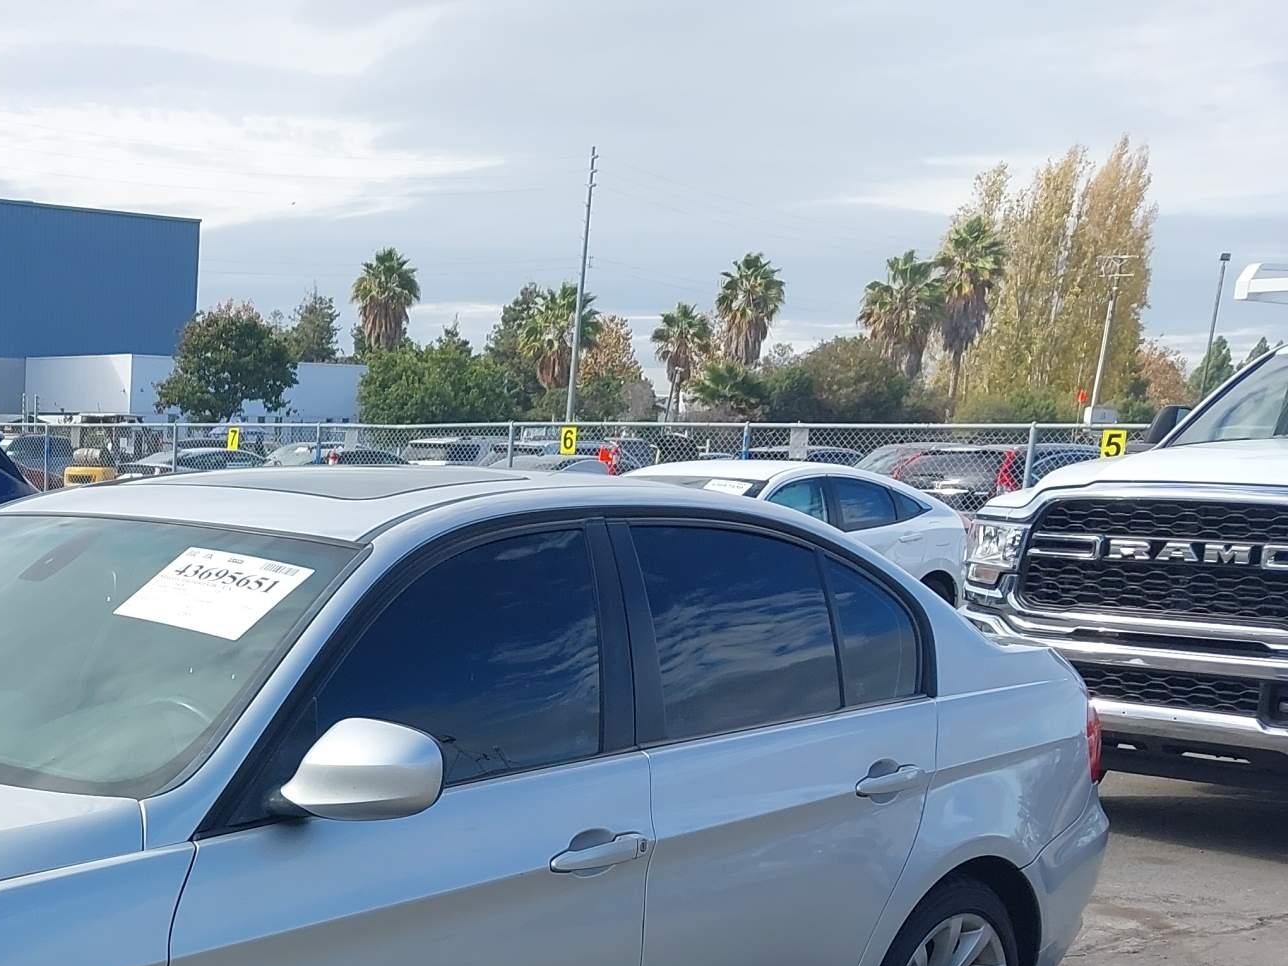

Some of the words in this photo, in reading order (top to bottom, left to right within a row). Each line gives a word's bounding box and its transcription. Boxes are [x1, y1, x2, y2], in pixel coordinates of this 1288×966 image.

[230, 429, 238, 447] 7
[563, 429, 574, 450] 6
[1104, 433, 1122, 458] 5
[1105, 539, 1253, 565] RAM
[174, 563, 280, 593] 43695651
